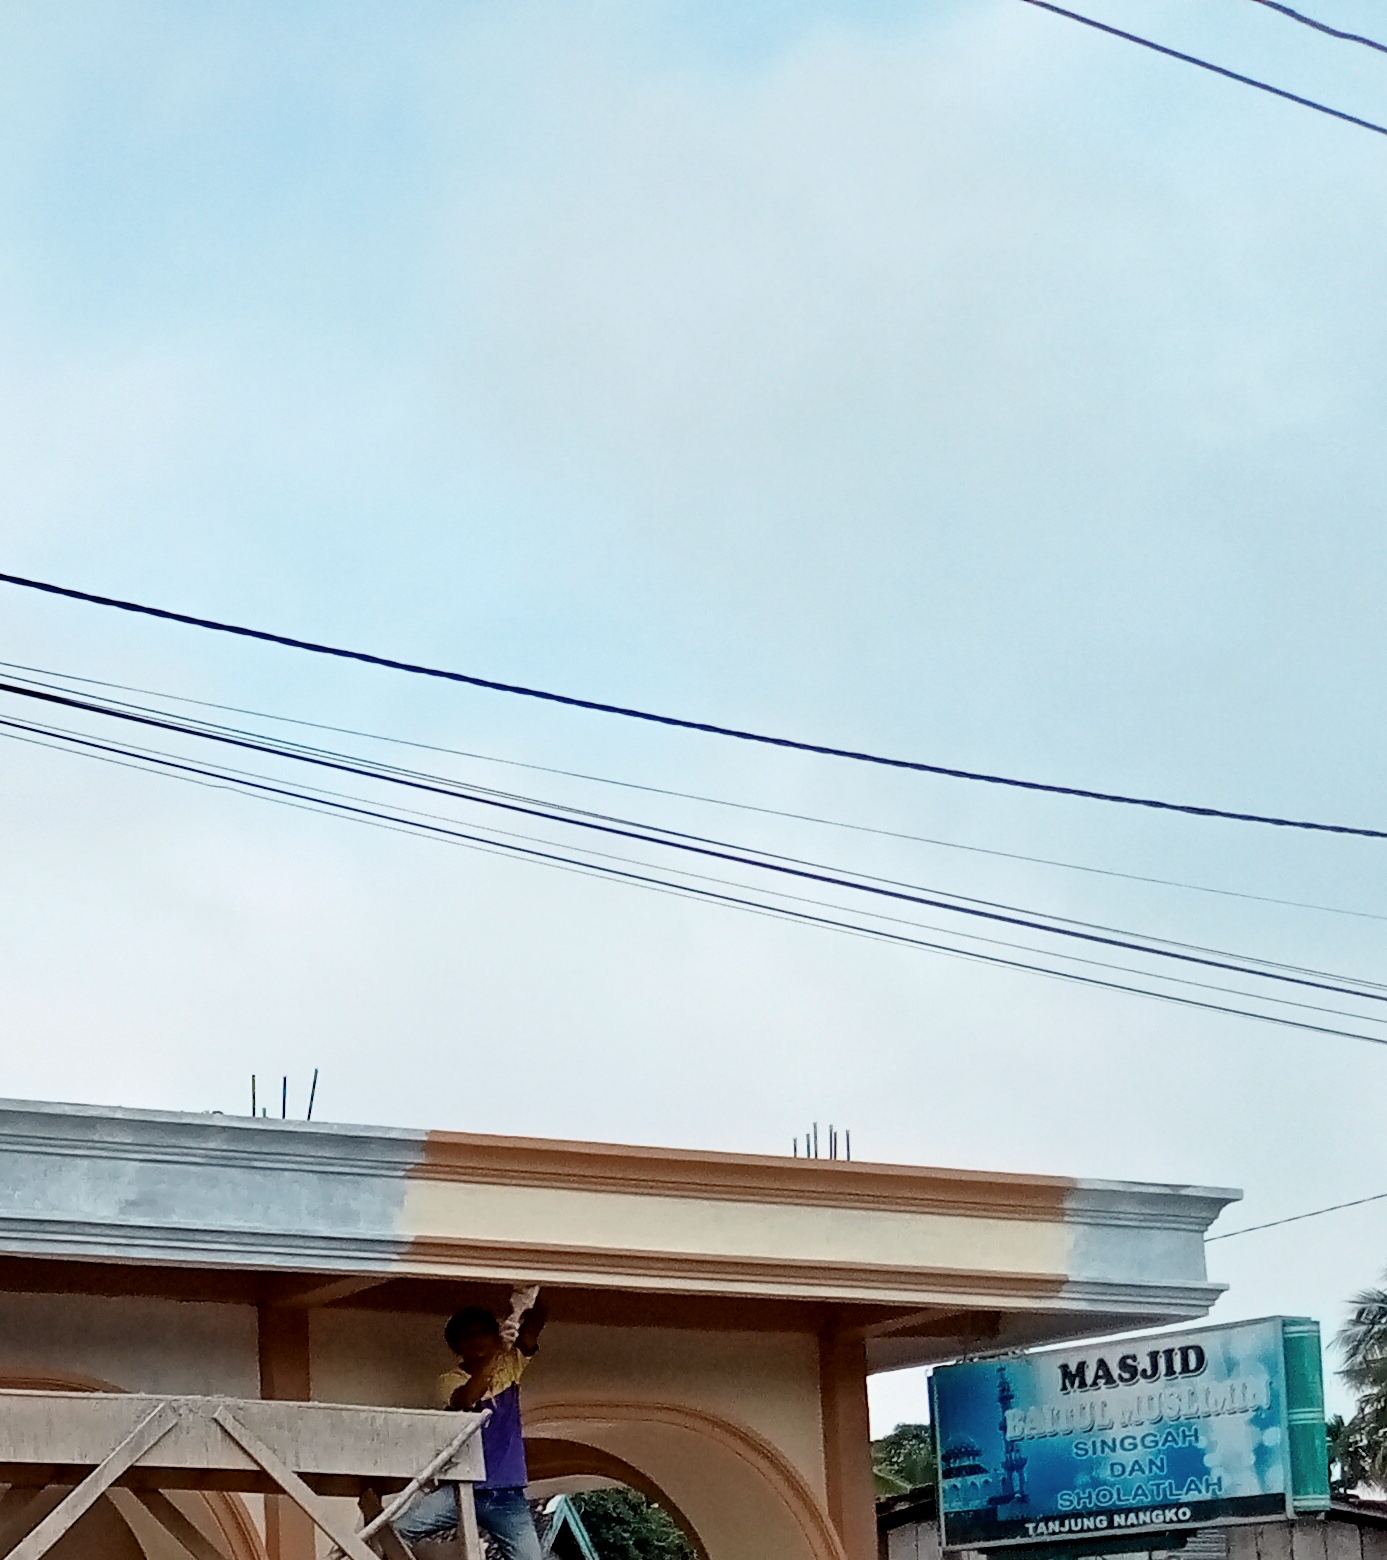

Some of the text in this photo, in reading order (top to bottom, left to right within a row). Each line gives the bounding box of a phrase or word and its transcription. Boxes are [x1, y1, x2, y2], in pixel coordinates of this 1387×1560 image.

[1058, 1344, 1208, 1394] MASJID
[1073, 1427, 1200, 1458] SINGGAH
[1109, 1456, 1165, 1478] DAN
[1057, 1475, 1223, 1510] SHOLATLAH
[1025, 1507, 1191, 1536] TANJUNG NANGKO
